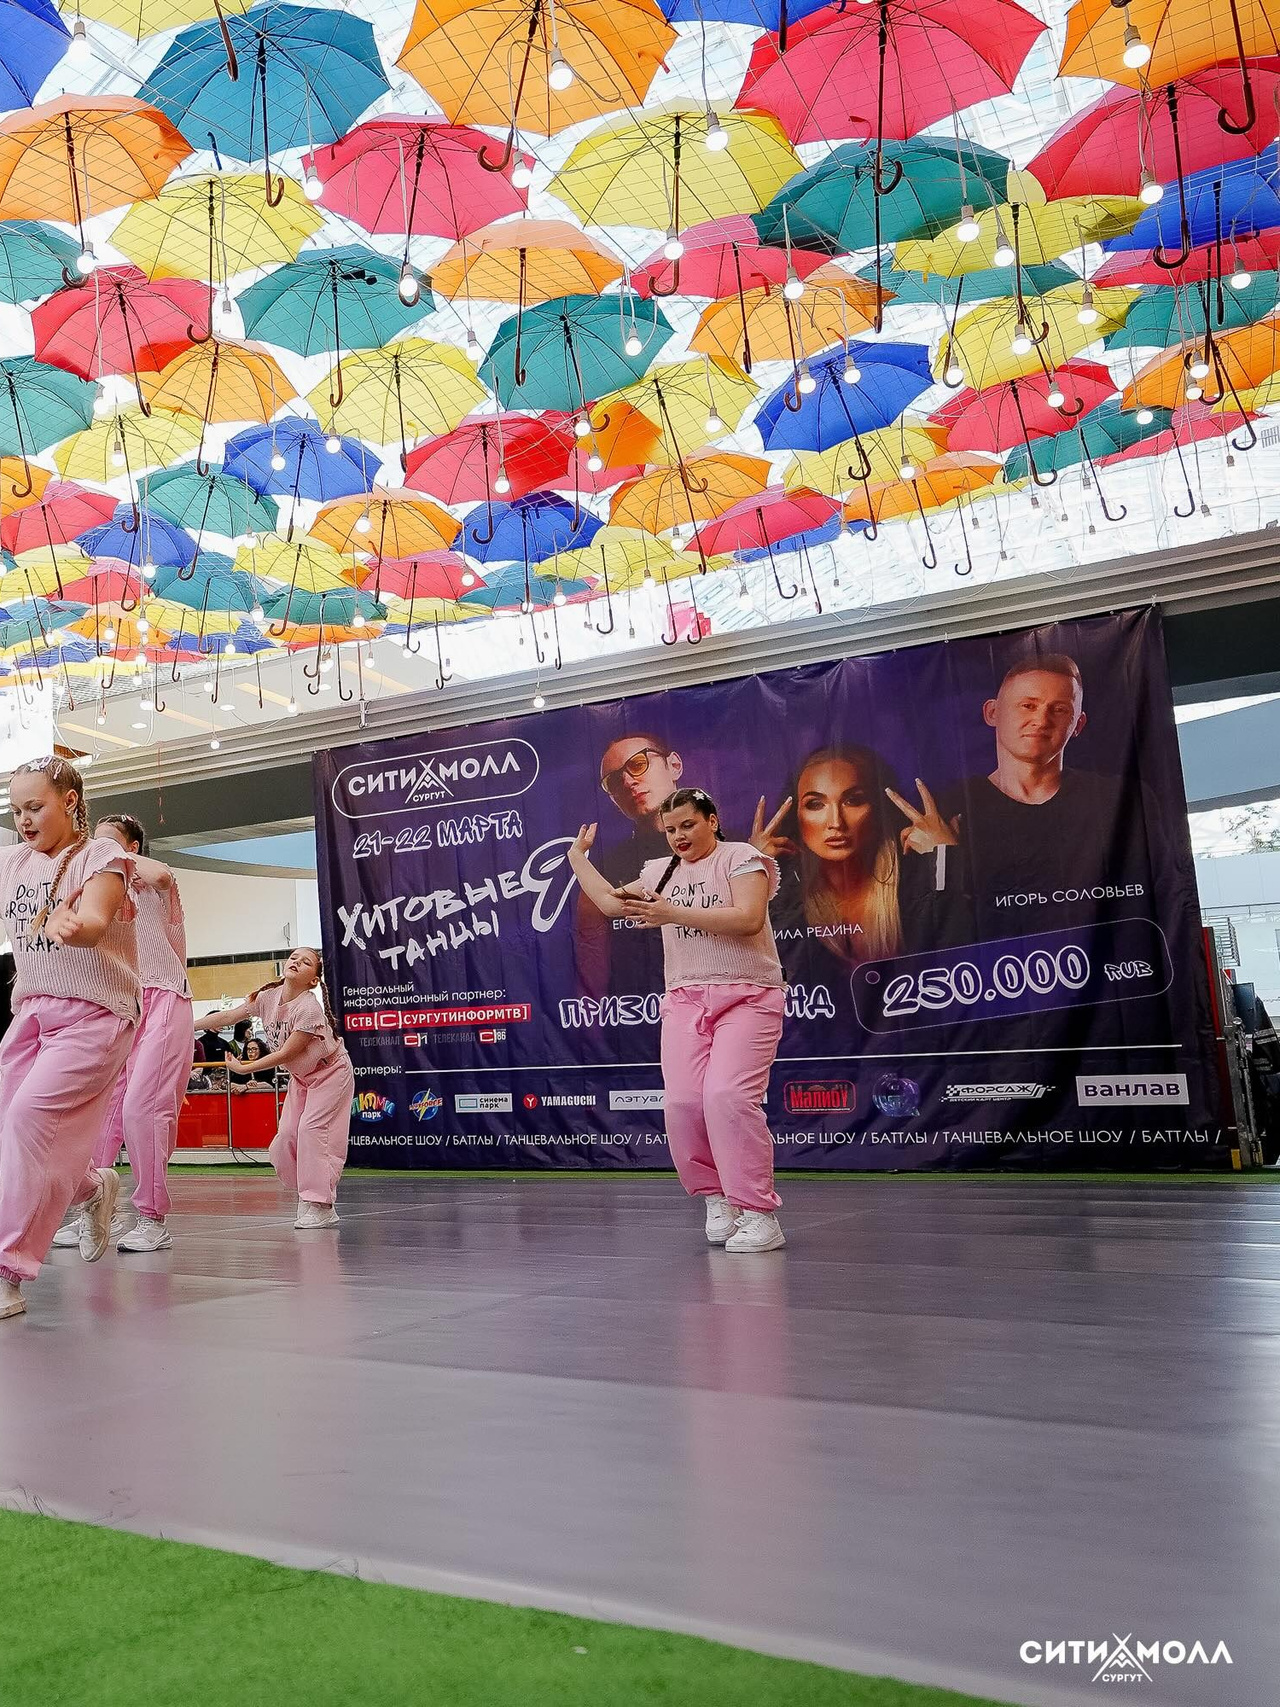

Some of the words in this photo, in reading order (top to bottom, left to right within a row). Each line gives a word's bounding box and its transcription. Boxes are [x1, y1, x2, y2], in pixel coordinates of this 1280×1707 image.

[412, 791, 446, 802] СУРГУТ
[352, 825, 432, 859] 21-22
[437, 809, 523, 848] МАРТА
[995, 890, 1048, 908] ИГОРЬ
[1052, 883, 1145, 904] СОЛОВЬЕВ
[337, 871, 524, 950] ХИТОВЫЕ
[378, 910, 500, 970] ТАНЦЫ
[773, 928, 804, 940] ИЛА
[807, 923, 864, 938] РЕДИНА
[342, 981, 415, 997] Генеральный
[882, 944, 1090, 1018] 250.000
[1104, 960, 1154, 982] RUB
[343, 989, 449, 1009] информационный
[451, 988, 507, 1001] партнер:
[559, 993, 662, 1028] ПРИЗО
[784, 984, 836, 1019] НД
[359, 1034, 400, 1047] ТЕЛЕКАНАЛ
[433, 1032, 476, 1044] ТЕЛЕКАНАЛ
[353, 1065, 402, 1076] артнеры:
[961, 1085, 1032, 1094] ФОРСАЖ
[1084, 1081, 1180, 1098] ванлав
[541, 1095, 596, 1106] YAMAGUCHI
[362, 1111, 381, 1119] парк
[348, 1135, 413, 1146] НЦЕВАЛЬНОЕ
[415, 1135, 442, 1146] ШОУ
[453, 1134, 494, 1146] БАТТЛЫ
[504, 1133, 597, 1147] ТАНЦЕВАЛЬНОЕ
[600, 1133, 632, 1145] ШОУ
[645, 1133, 668, 1145] БАТ
[819, 1132, 856, 1144] ШОУ
[871, 1132, 928, 1144] БАТТЛЫ
[943, 1130, 1074, 1146] ТАНЦЕВАЛЬНОЕ
[1078, 1130, 1122, 1144] ШОУ
[1142, 1129, 1208, 1143] БАТТЛЫ
